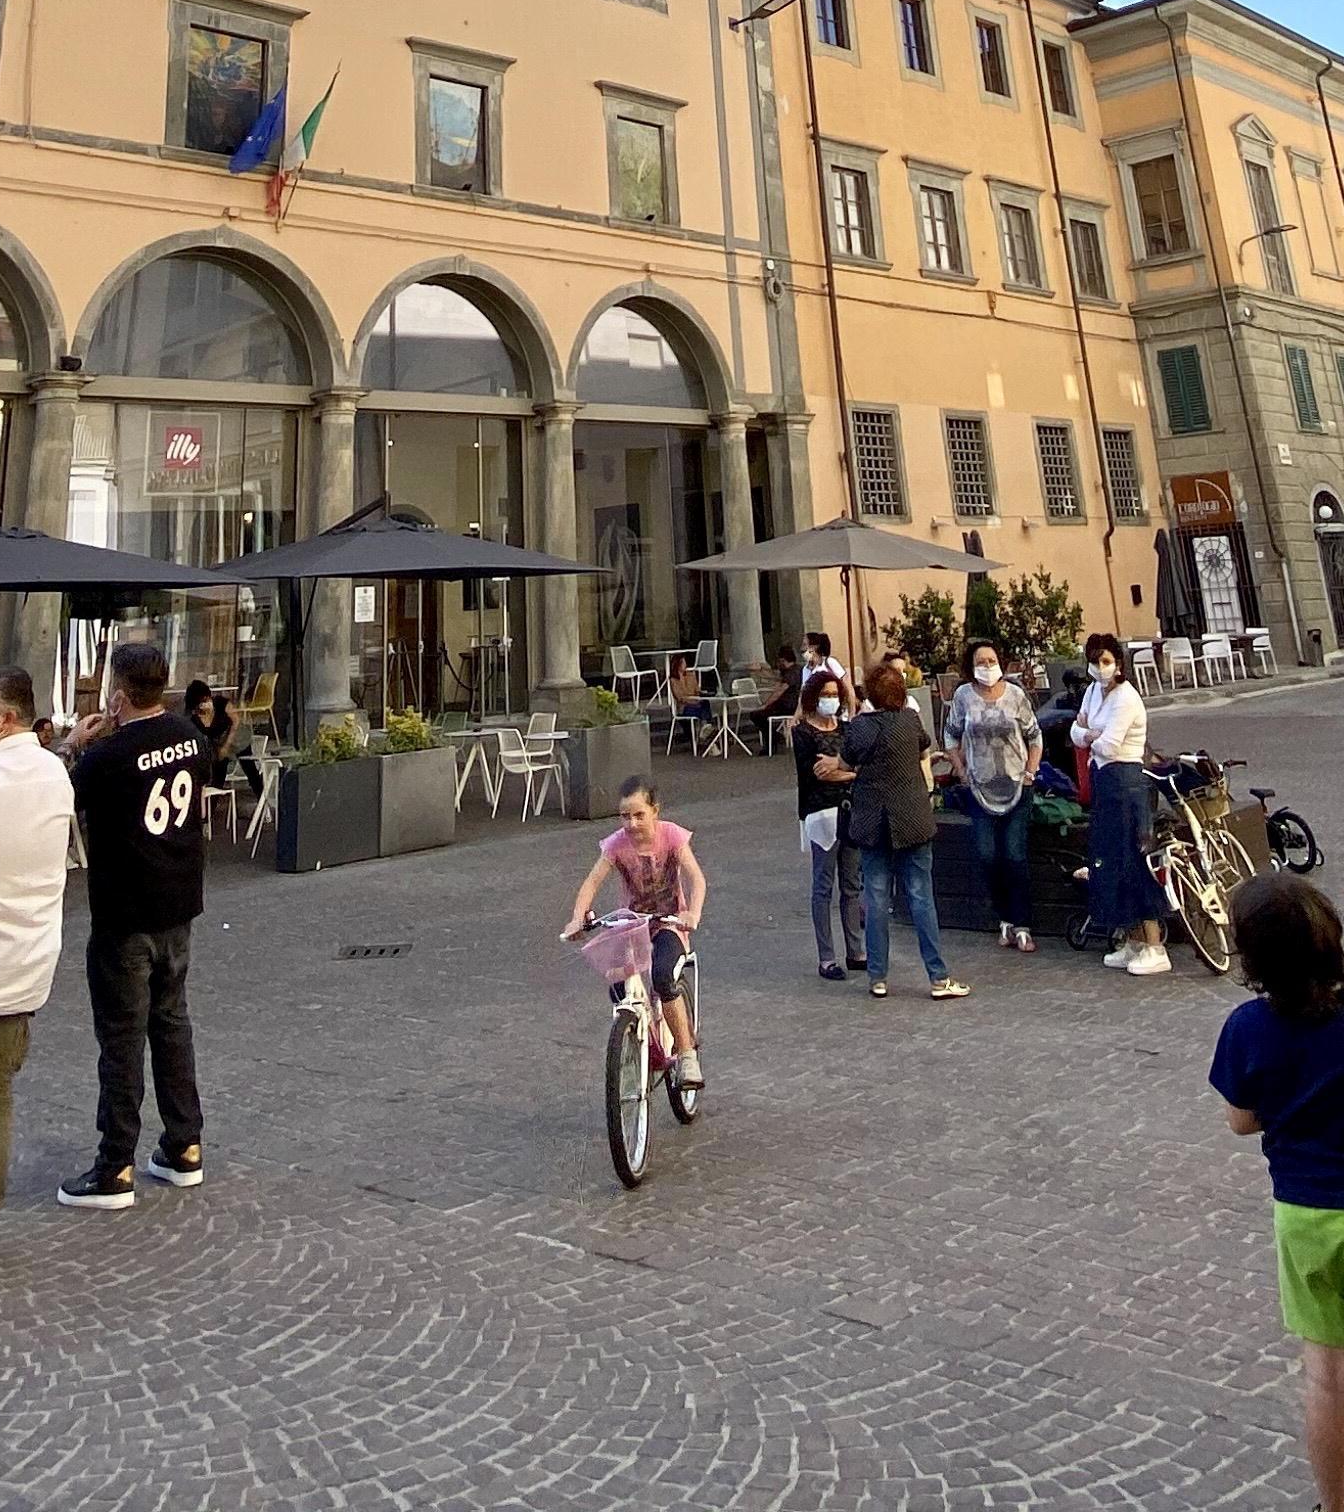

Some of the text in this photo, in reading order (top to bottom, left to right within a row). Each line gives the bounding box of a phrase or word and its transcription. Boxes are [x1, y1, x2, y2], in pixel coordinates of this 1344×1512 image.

[166, 433, 201, 466] illy
[137, 738, 199, 772] GROSSI
[143, 769, 193, 836] 69
